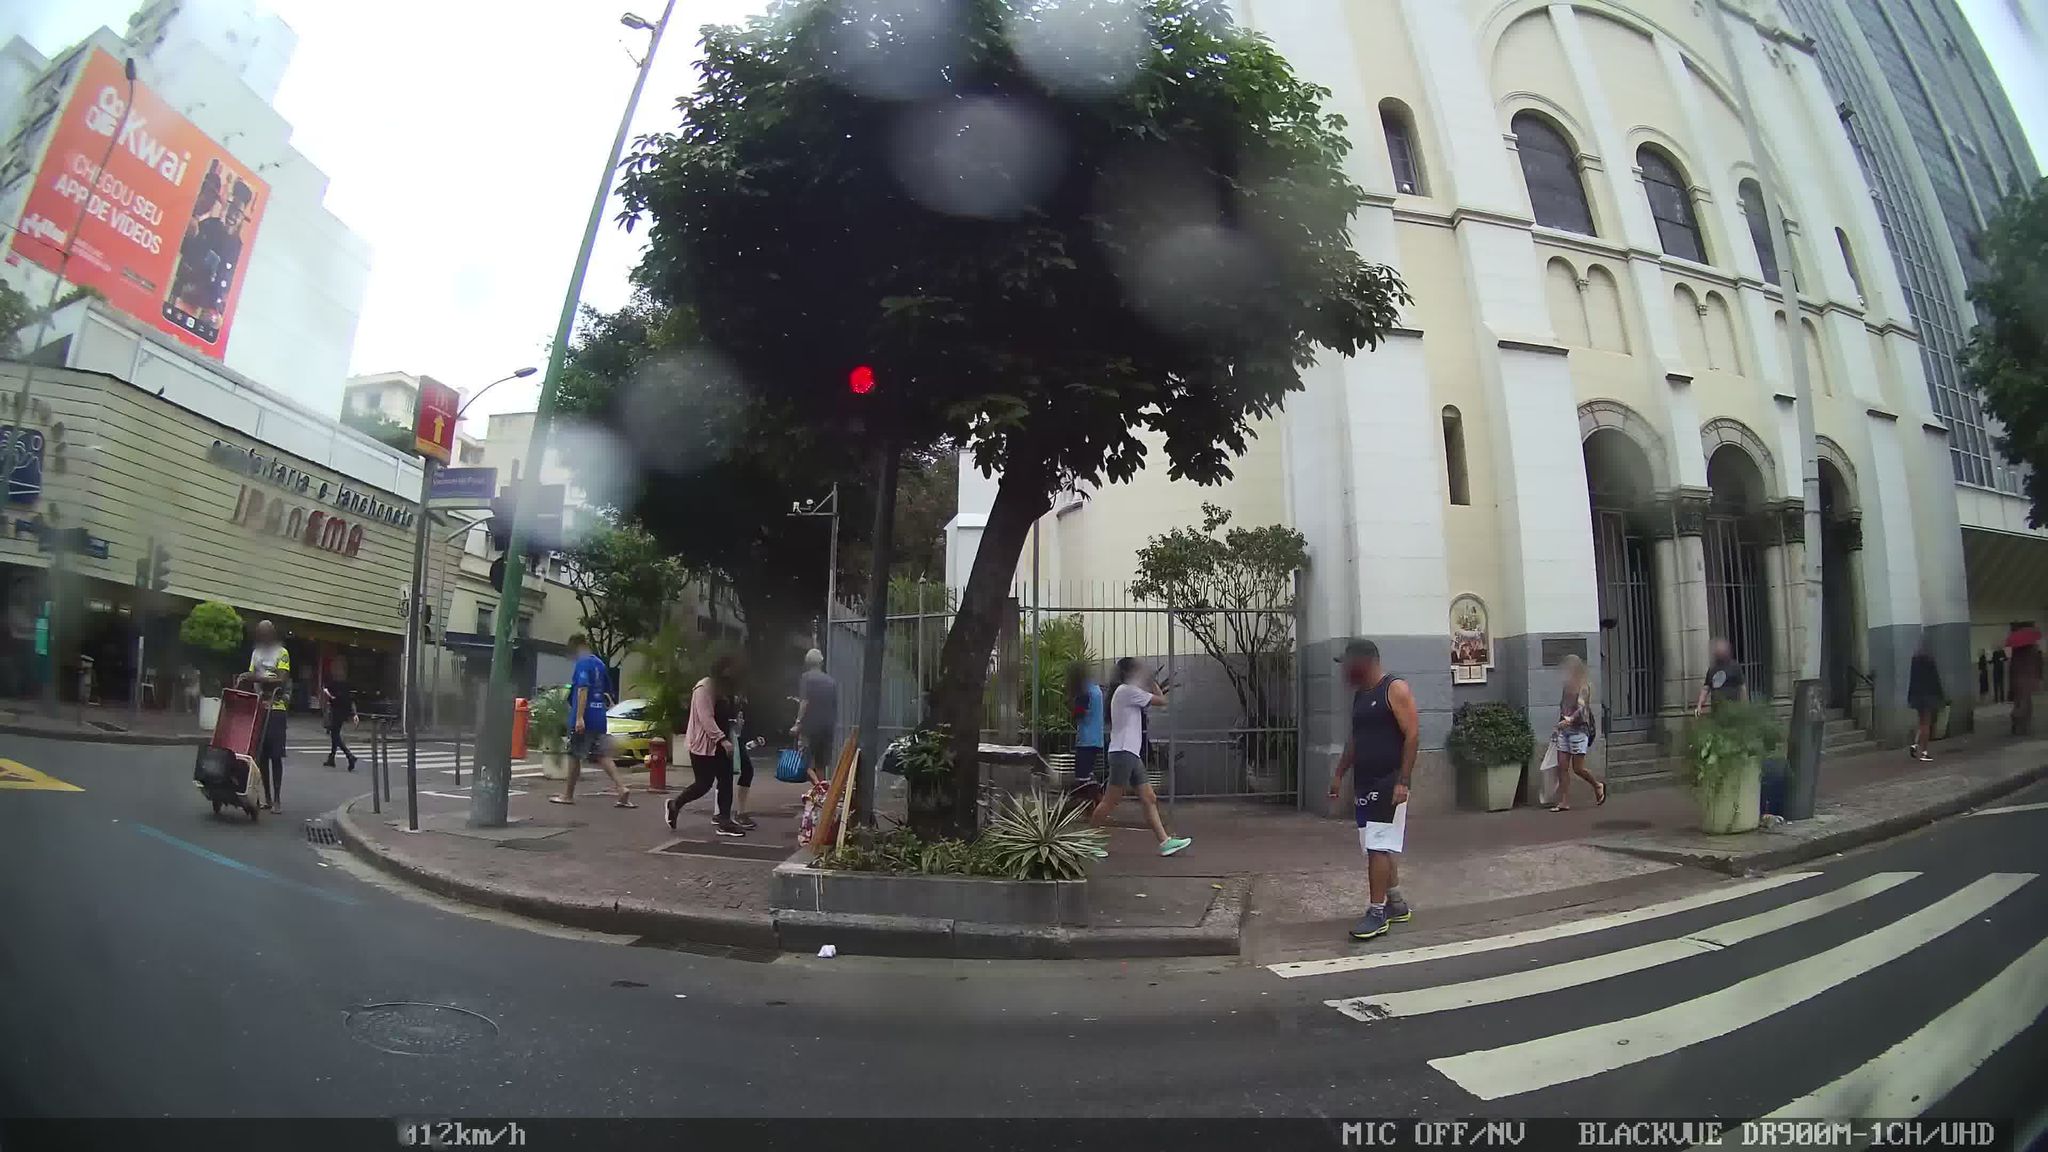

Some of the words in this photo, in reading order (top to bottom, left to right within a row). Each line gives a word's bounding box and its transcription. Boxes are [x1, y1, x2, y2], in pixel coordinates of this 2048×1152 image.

[117, 107, 192, 187] Kwai
[55, 174, 90, 205] APP
[86, 194, 112, 222] DE
[110, 207, 162, 254] VÍDEOS
[73, 154, 134, 206] CHGOU
[133, 195, 164, 227] SEU
[318, 482, 329, 499] e
[333, 481, 414, 529] lanchonete
